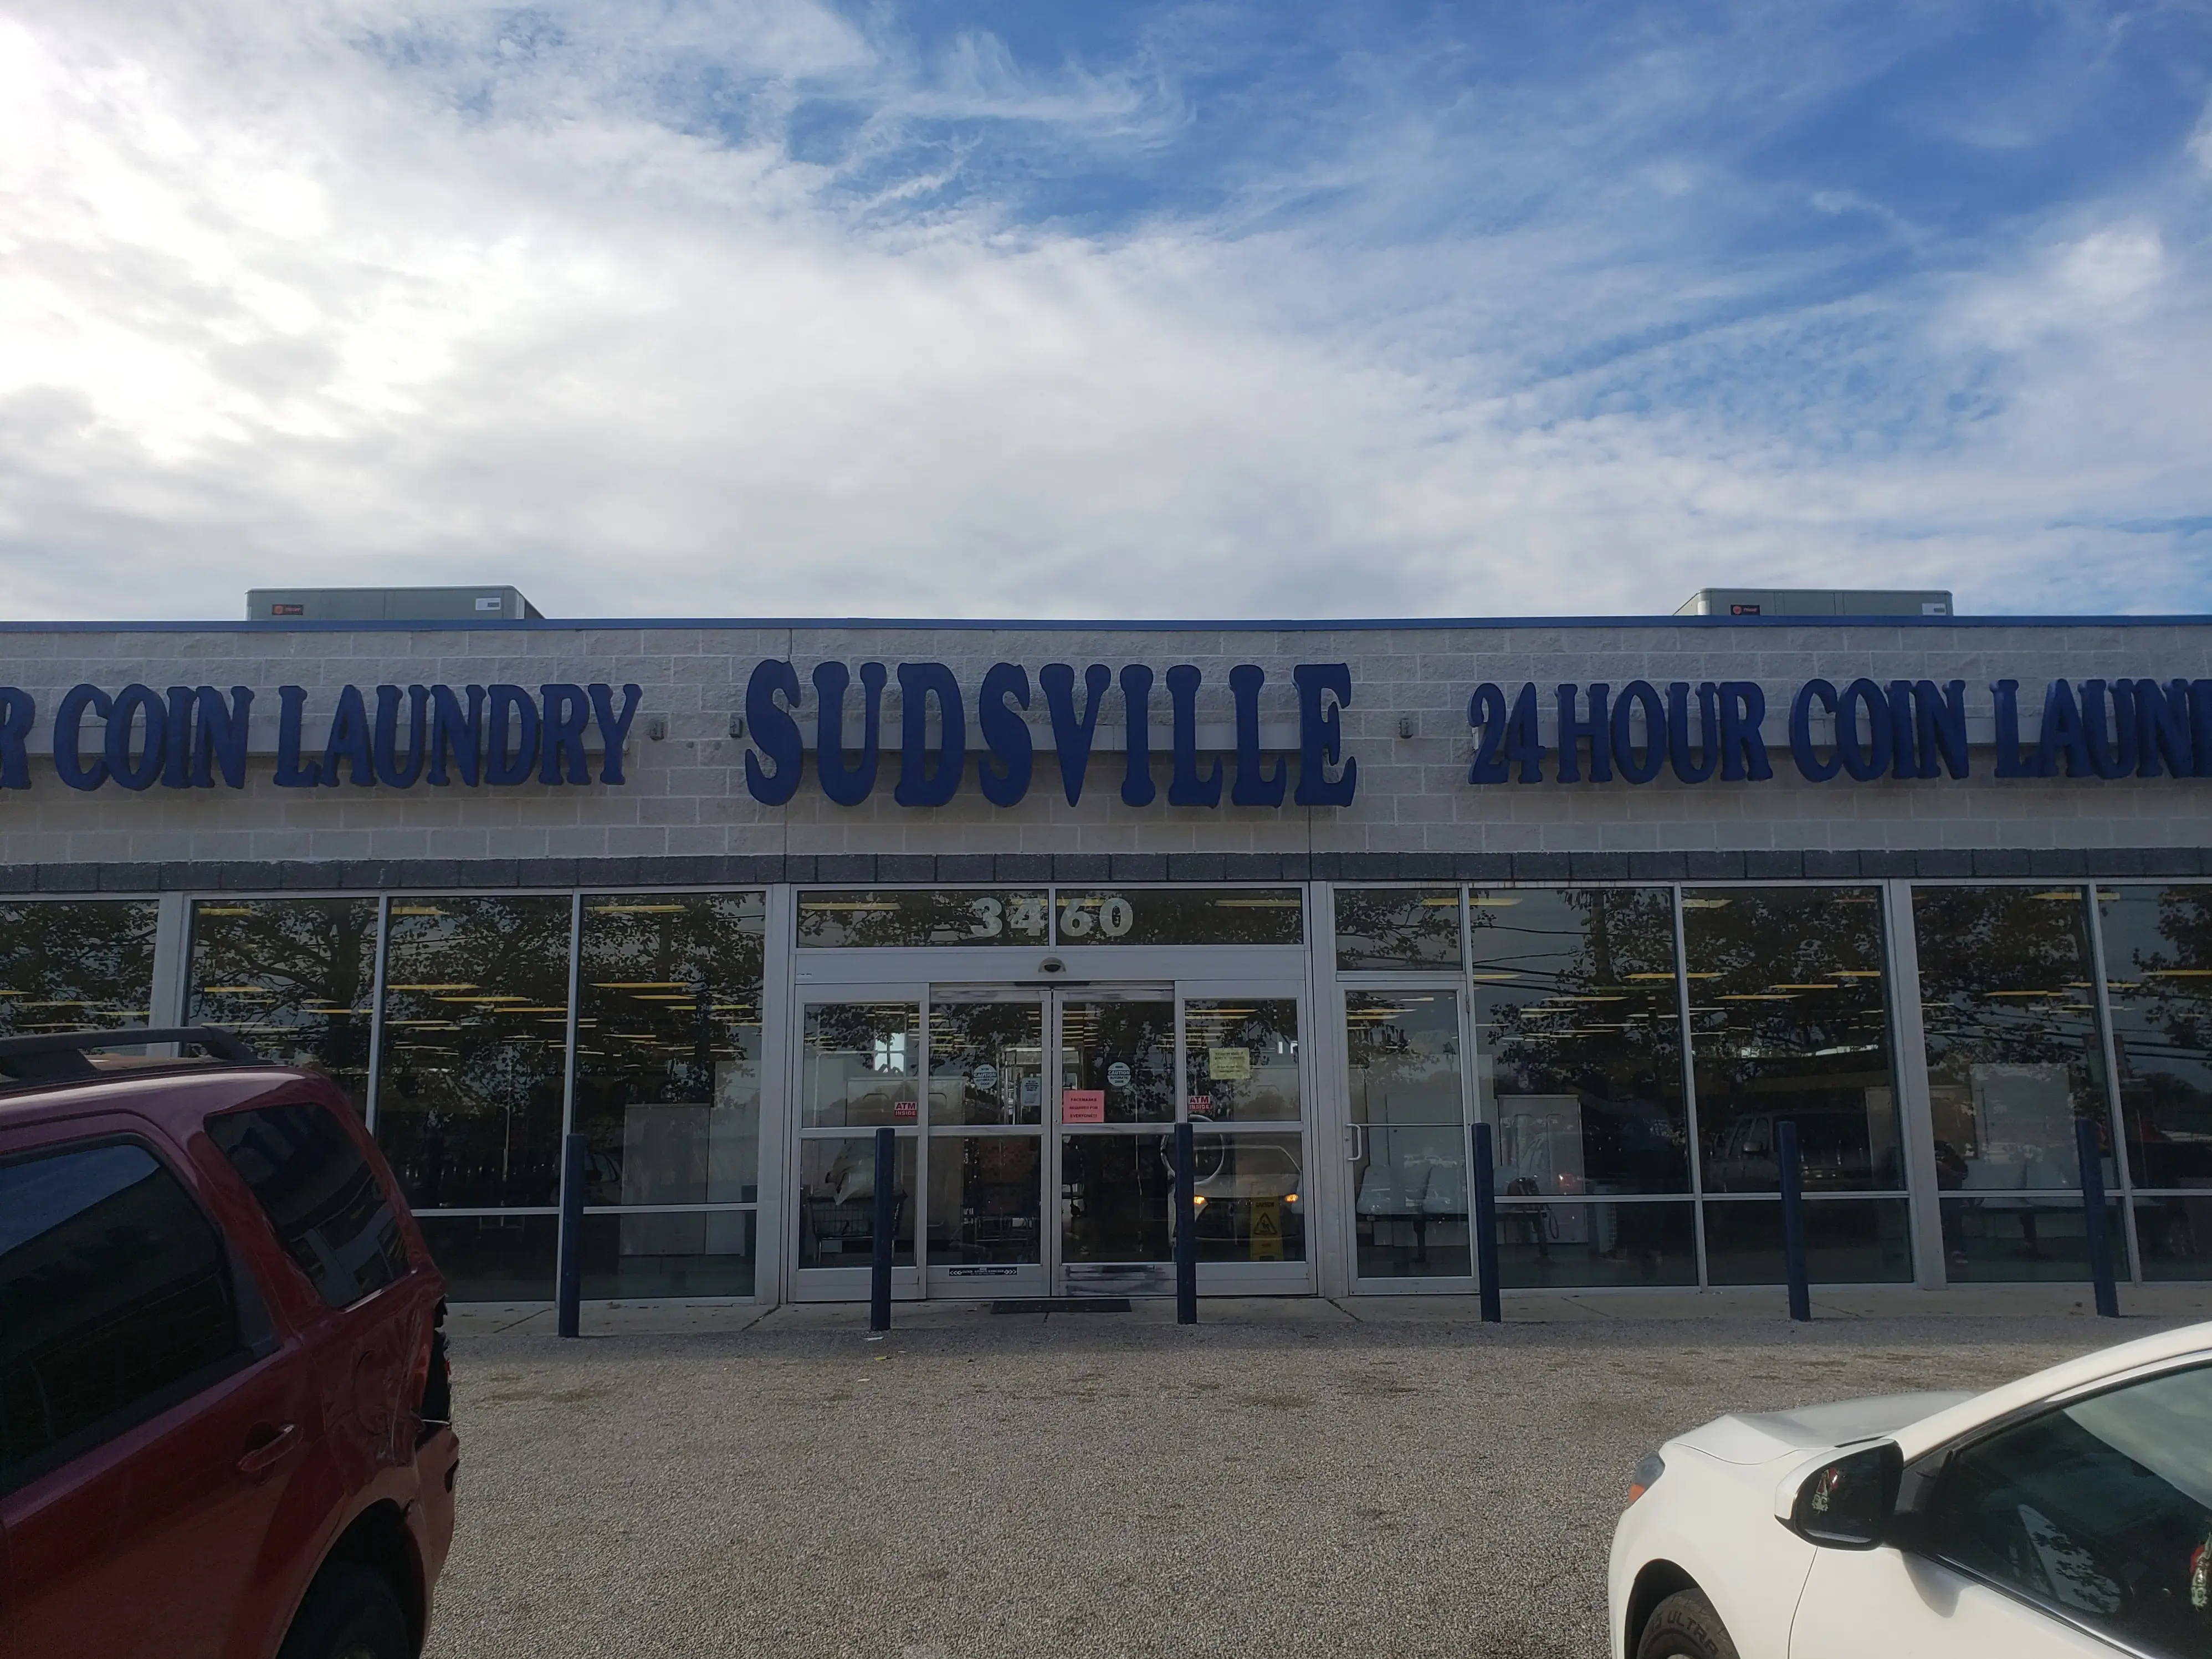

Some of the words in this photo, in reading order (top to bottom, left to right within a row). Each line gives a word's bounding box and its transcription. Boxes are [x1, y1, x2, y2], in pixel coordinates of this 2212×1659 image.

[53, 683, 255, 792] COIN
[273, 683, 643, 789] LAUNDRY
[745, 659, 1357, 808] SUDSVILLE
[1467, 682, 1546, 785] 24
[1555, 680, 1773, 785] HOUR
[1789, 678, 1969, 783] COIN
[969, 897, 1134, 938] 3460
[1667, 1610, 1719, 1656] ULTRA
